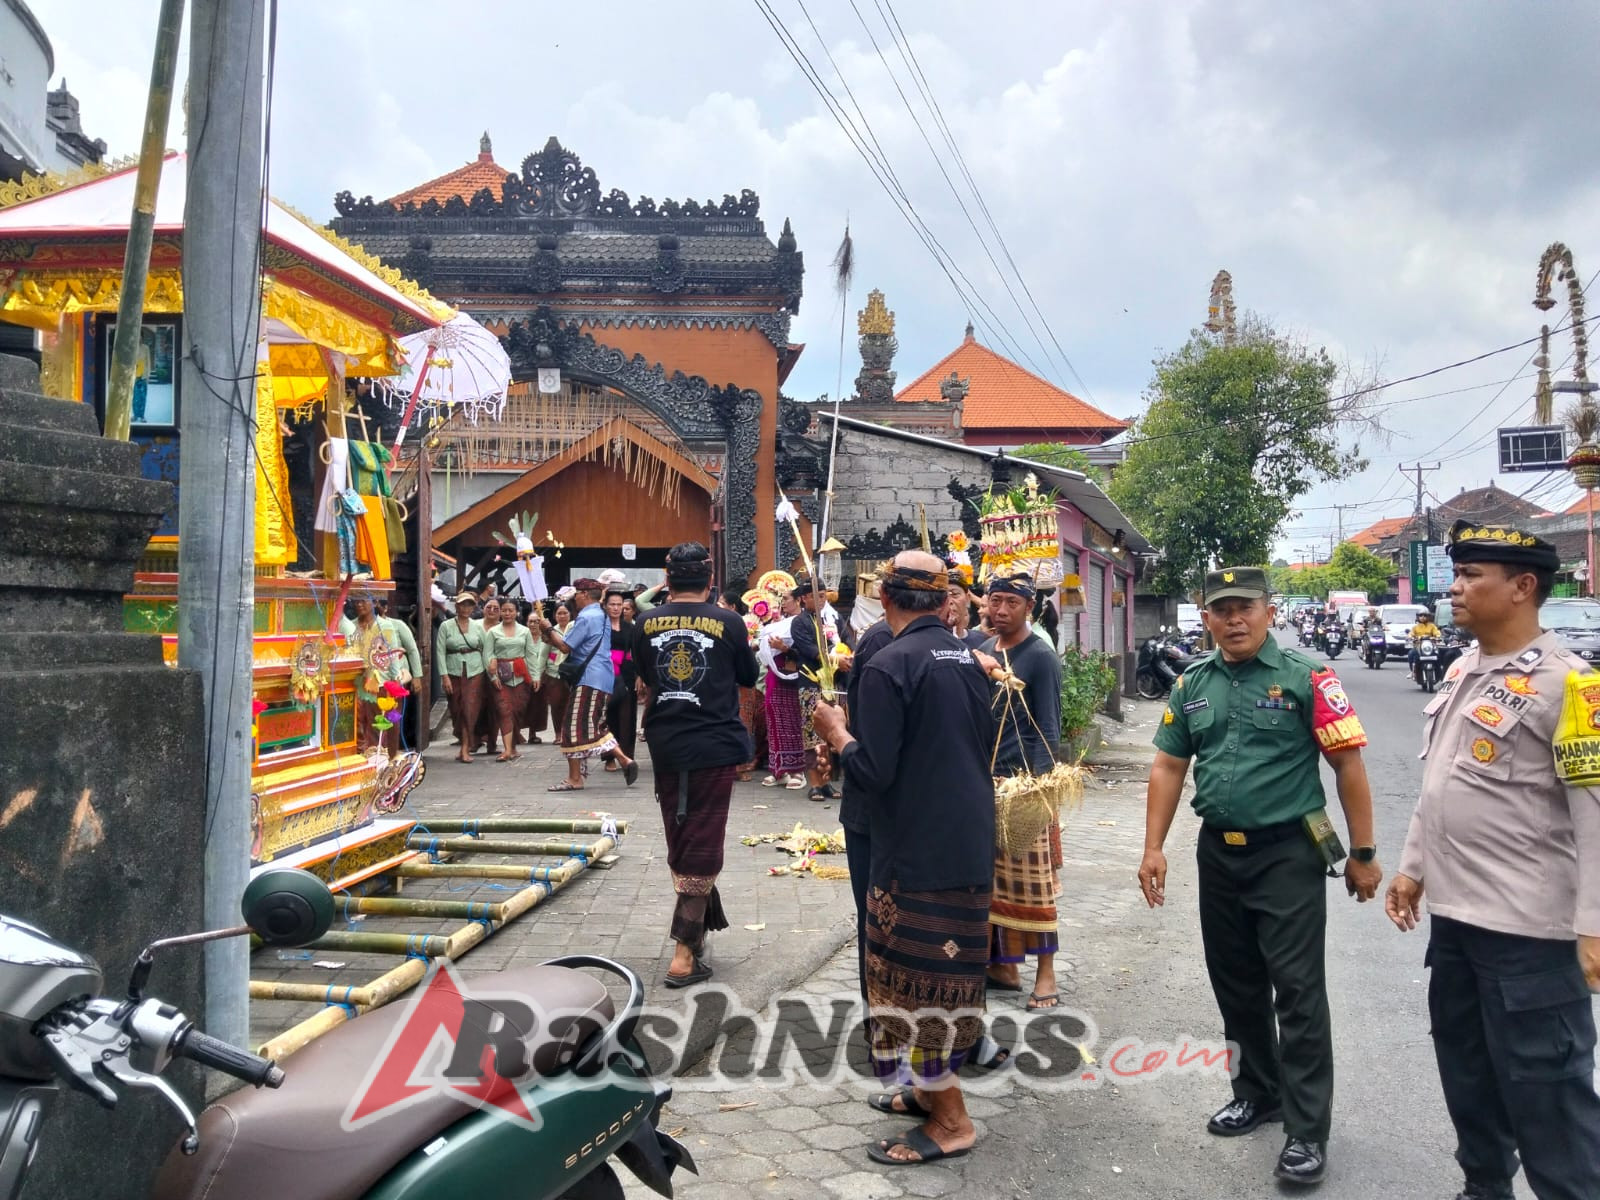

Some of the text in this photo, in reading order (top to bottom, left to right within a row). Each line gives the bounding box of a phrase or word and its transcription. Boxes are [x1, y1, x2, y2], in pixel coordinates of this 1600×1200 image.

[1484, 684, 1527, 711] POLRI
[1563, 757, 1598, 769] DESA
[564, 1099, 643, 1169] SCOOPY
